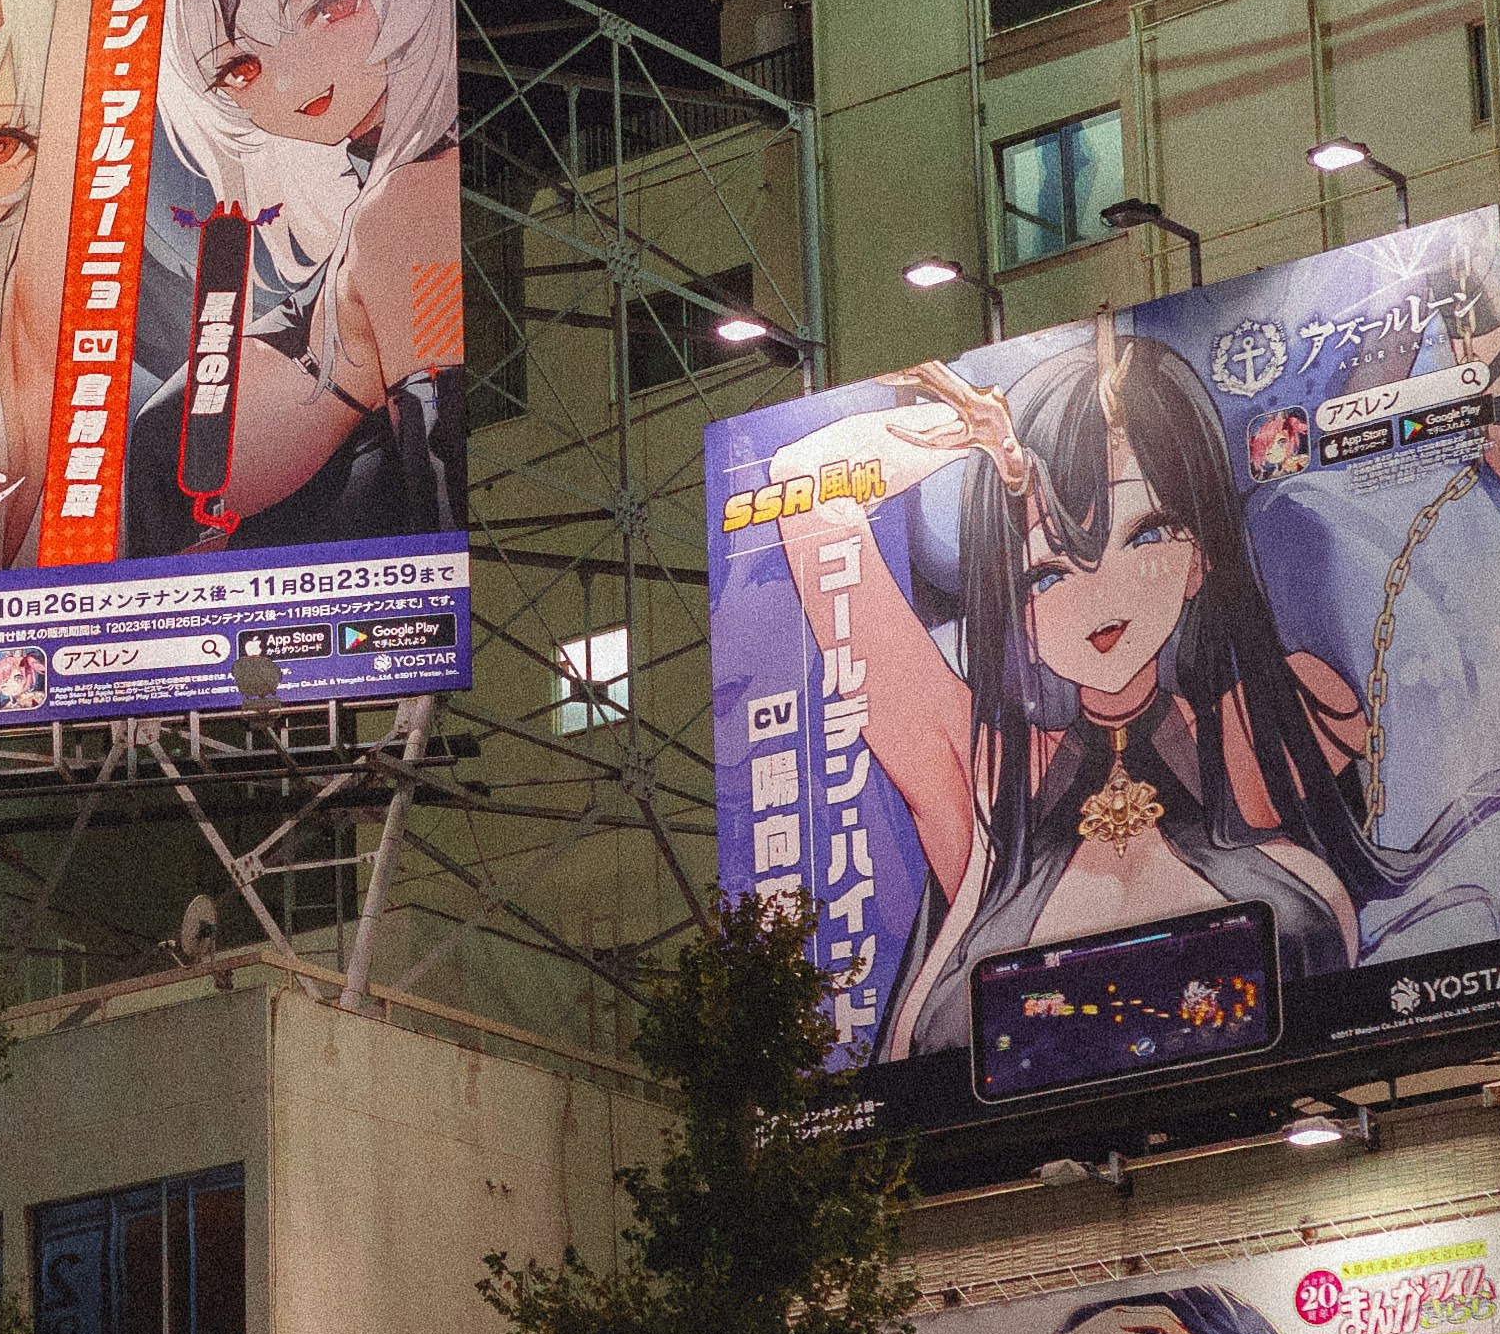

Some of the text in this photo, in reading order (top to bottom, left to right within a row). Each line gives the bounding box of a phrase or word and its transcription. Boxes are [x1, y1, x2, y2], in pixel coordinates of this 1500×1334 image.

[1299, 288, 1482, 374] アズールレーン
[78, 337, 114, 354] CV
[1339, 334, 1446, 370] AZUR LANE
[1327, 391, 1400, 425] アズレン
[1426, 404, 1482, 425] Google Play
[1342, 428, 1388, 447] App Store
[818, 459, 886, 504] 風帆
[722, 476, 815, 533] SSR
[267, 630, 324, 647] App Store
[373, 621, 440, 640] Google Play
[63, 648, 139, 669] アズレン
[267, 642, 323, 655] からダウンロード
[393, 652, 457, 669] YOSTAR
[754, 702, 792, 730] CV
[819, 535, 876, 1044] ゴールデン・ハインド
[1301, 1283, 1339, 1312] 20
